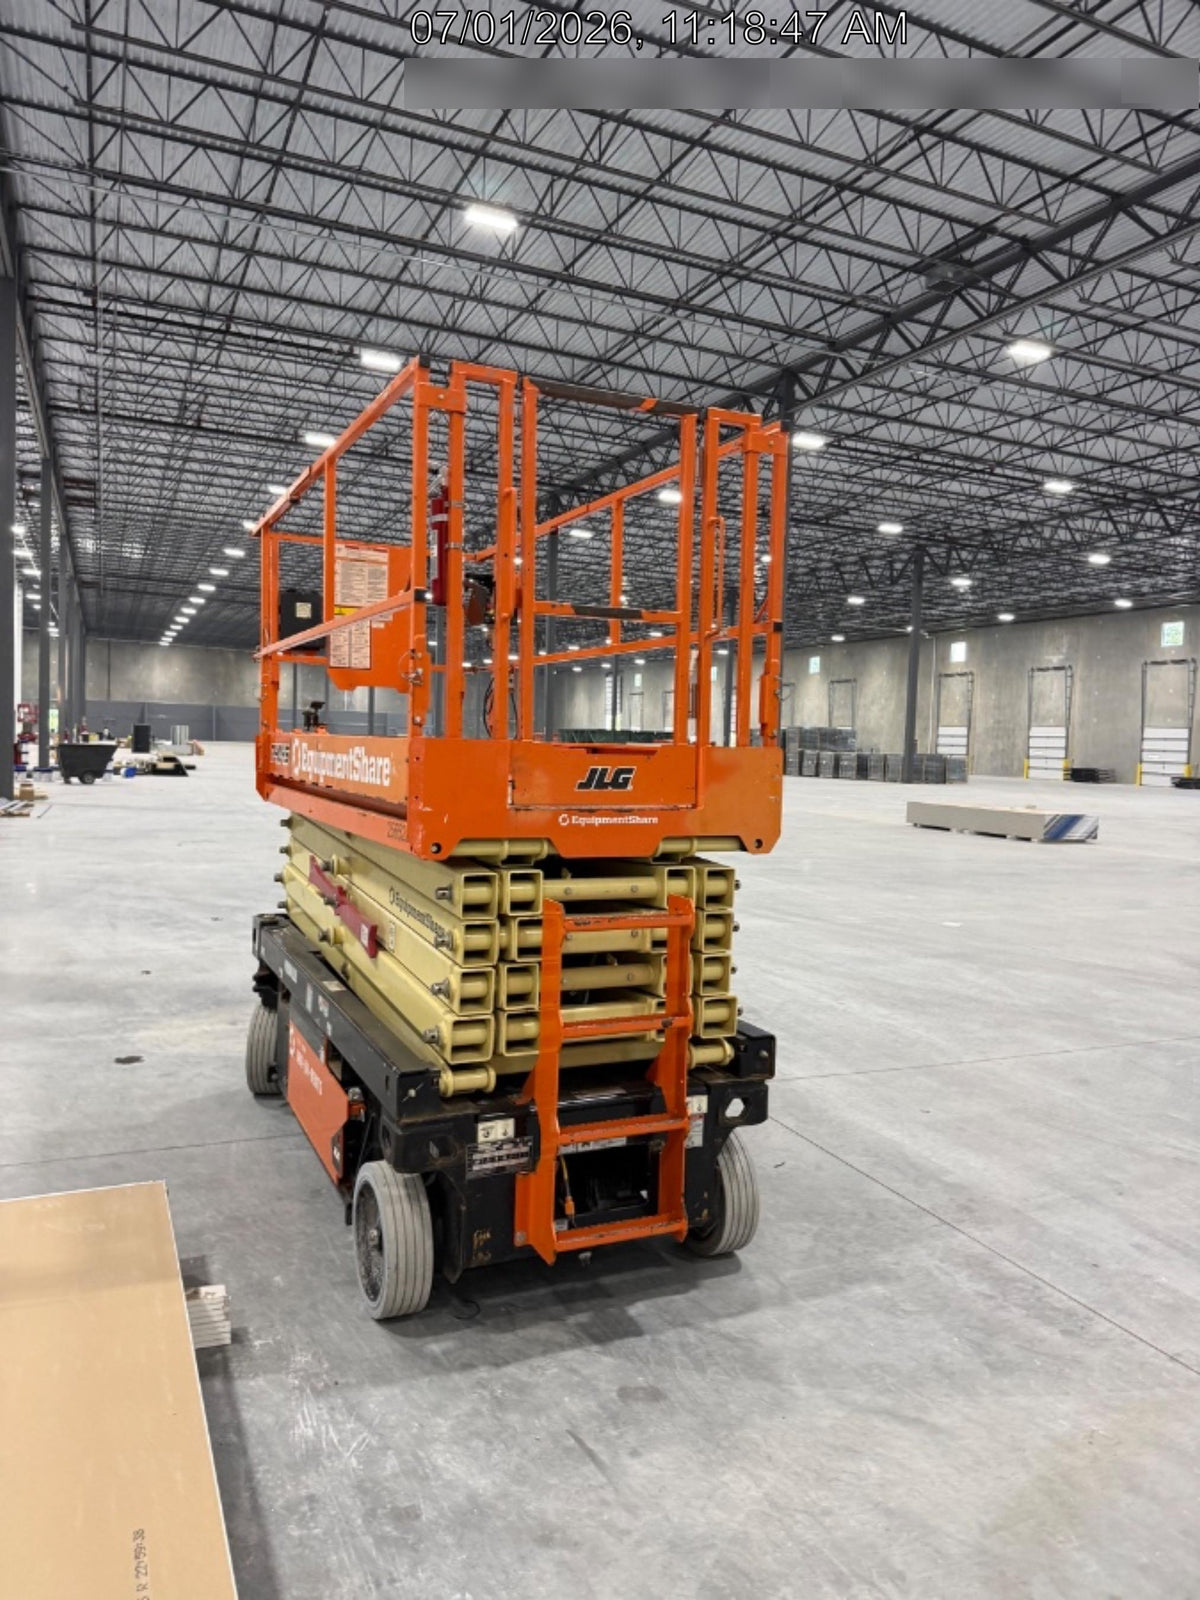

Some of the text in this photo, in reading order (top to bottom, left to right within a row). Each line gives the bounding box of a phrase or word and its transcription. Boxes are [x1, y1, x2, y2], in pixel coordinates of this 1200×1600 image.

[301, 743, 391, 787] EquipmentShare
[575, 765, 636, 791] JLG
[571, 815, 659, 827] EquipmentShare
